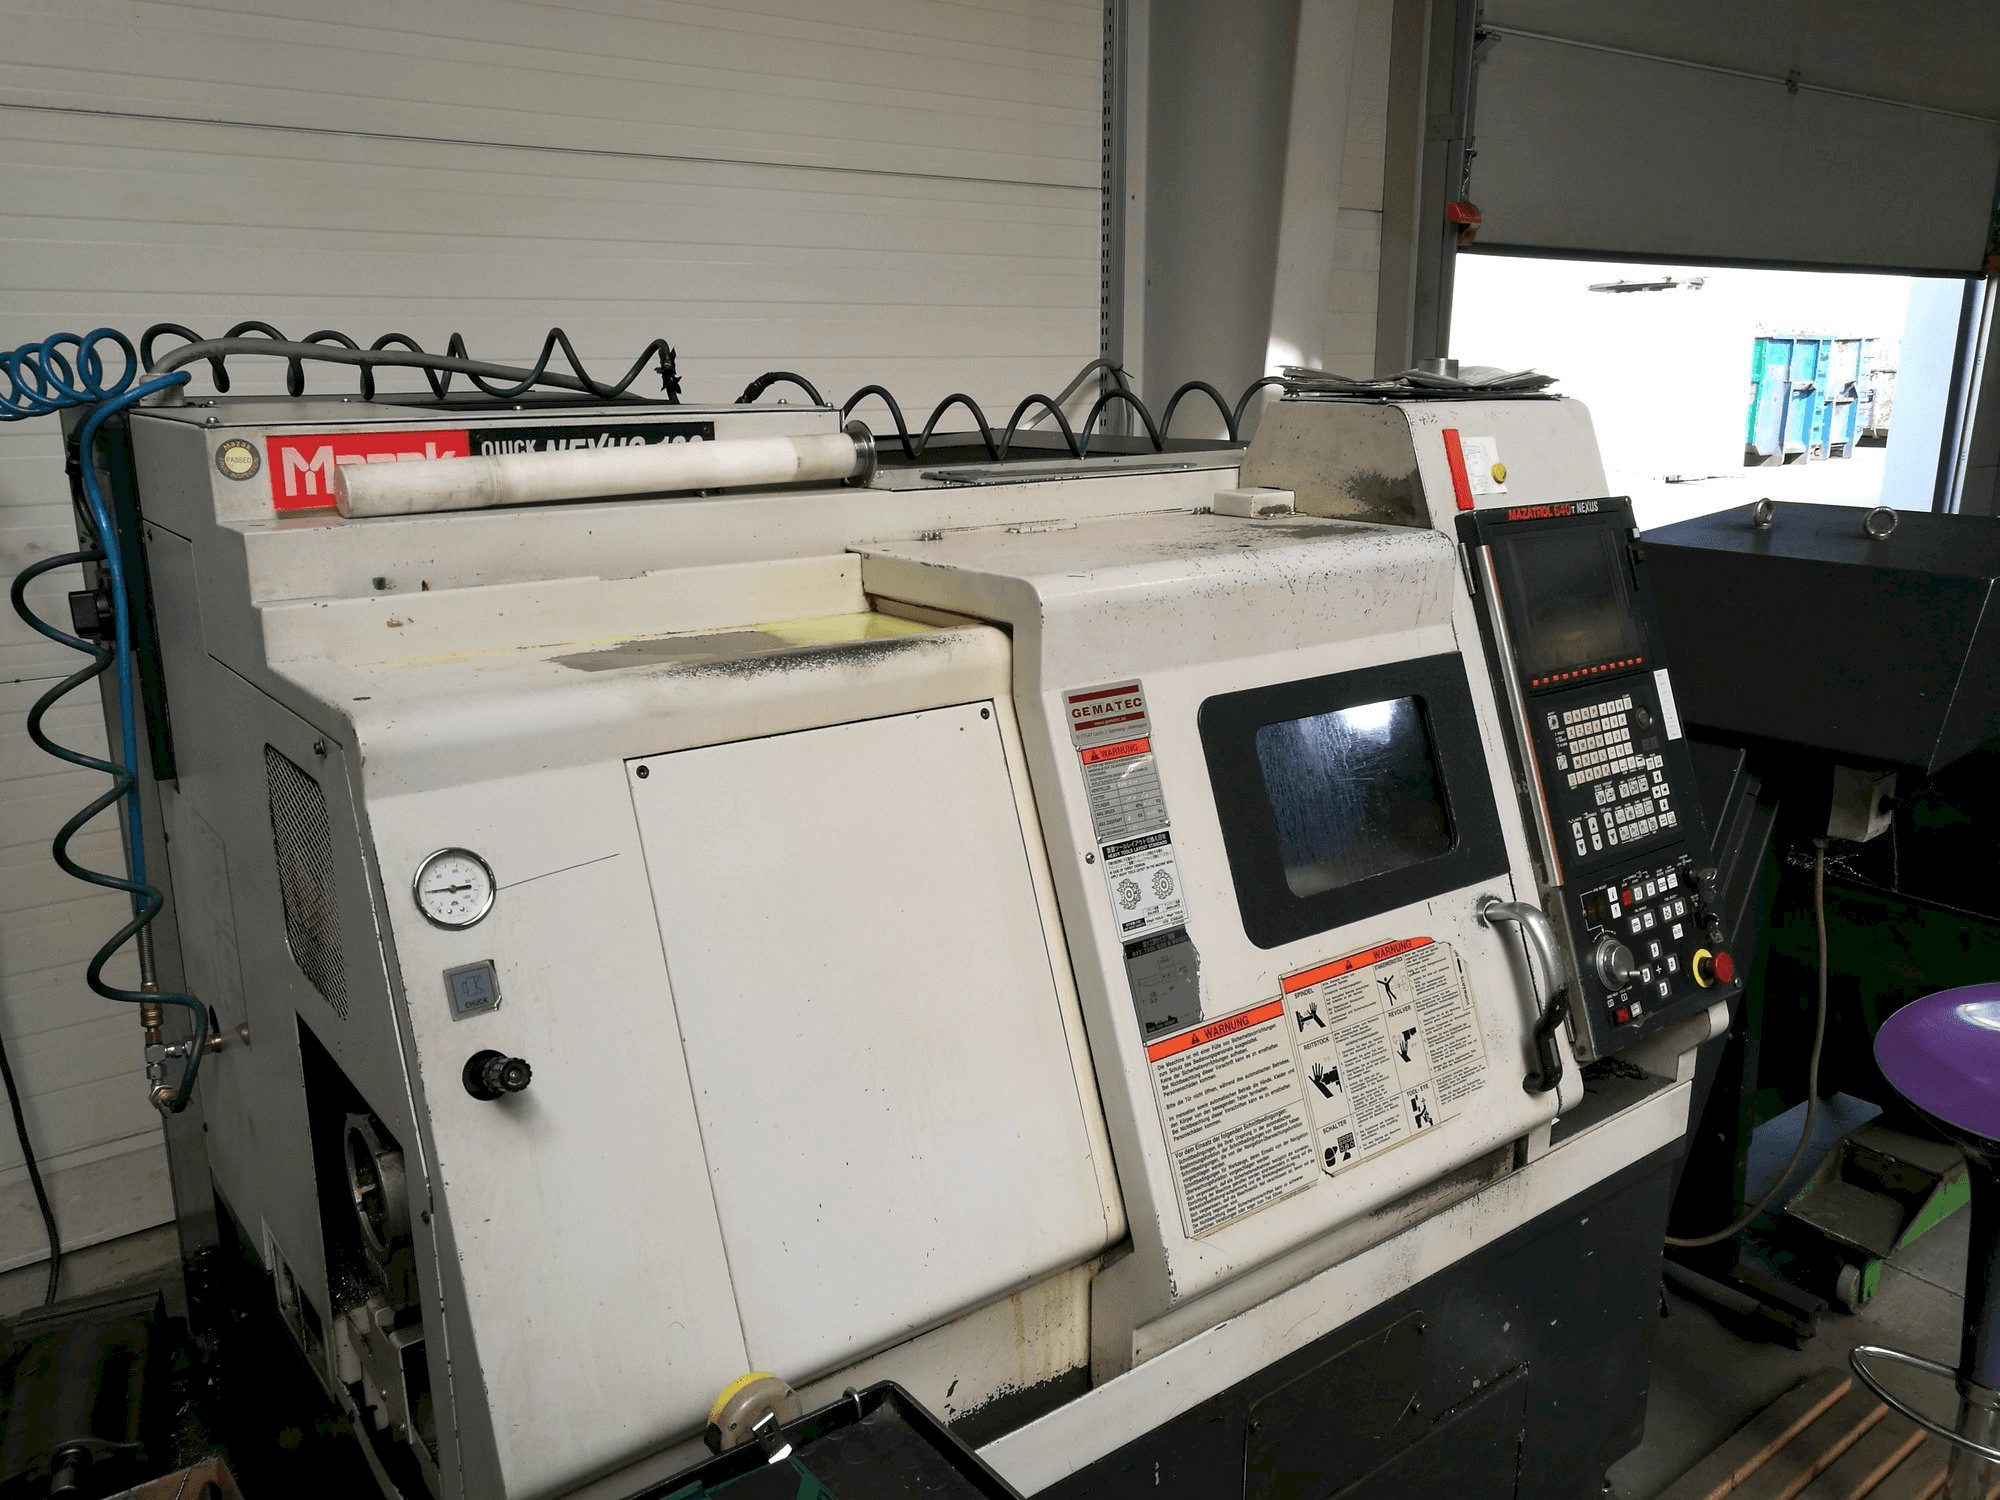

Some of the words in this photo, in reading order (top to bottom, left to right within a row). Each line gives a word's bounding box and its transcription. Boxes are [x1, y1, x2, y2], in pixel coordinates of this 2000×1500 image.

[1507, 506, 1552, 521] MAZATROL
[1576, 501, 1599, 514] NEXUS
[1072, 697, 1143, 719] GEMATEC
[1100, 743, 1138, 757] WARNUNG
[1148, 839, 1168, 848] STANDARD
[1372, 939, 1412, 959] WARNUNG
[1294, 987, 1314, 999] SPINDEL
[464, 998, 488, 1008] CHUCK
[1388, 1004, 1412, 1018] REVOLVER
[1204, 1015, 1249, 1039] WARNUNG
[1303, 1036, 1330, 1051] REITSTOCK
[1322, 1119, 1347, 1135] SCHALTER
